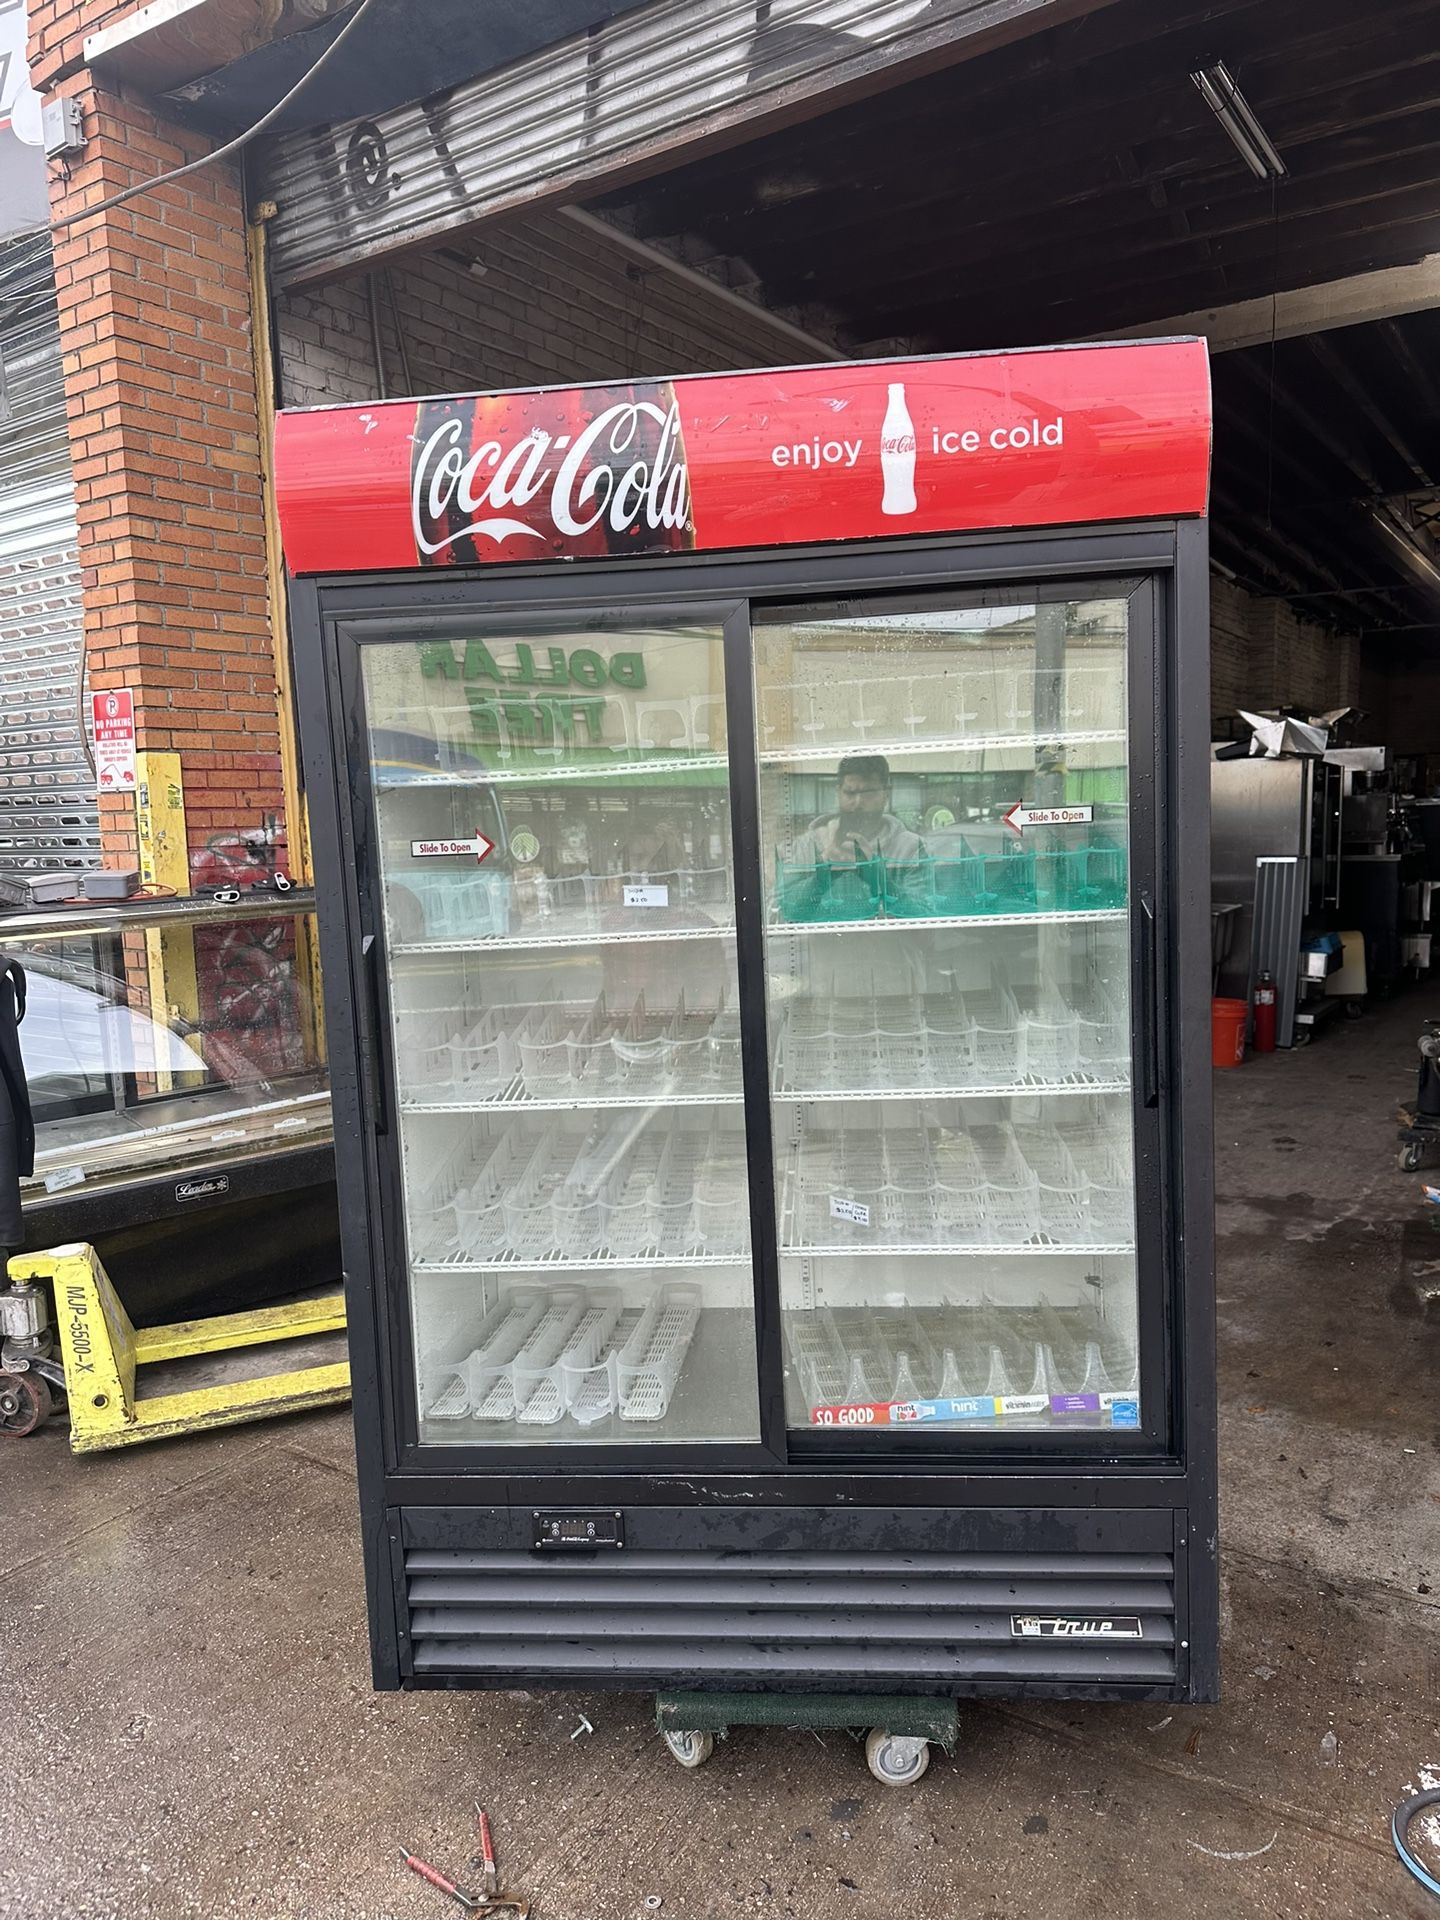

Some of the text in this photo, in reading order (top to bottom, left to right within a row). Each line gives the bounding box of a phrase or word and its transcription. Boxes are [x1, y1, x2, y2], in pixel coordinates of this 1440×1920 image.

[931, 416, 1064, 454] ice cold
[771, 436, 862, 469] enjoy
[412, 402, 693, 554] Coca-Cola
[96, 717, 132, 730] NO PARKING
[101, 729, 129, 740] ANY TIME
[1028, 810, 1084, 822] Slide To Open
[420, 843, 471, 853] Slide To Open
[66, 1286, 95, 1373] MJP-5500-X
[951, 1401, 978, 1413] hint
[816, 1408, 874, 1425] SO GOOD
